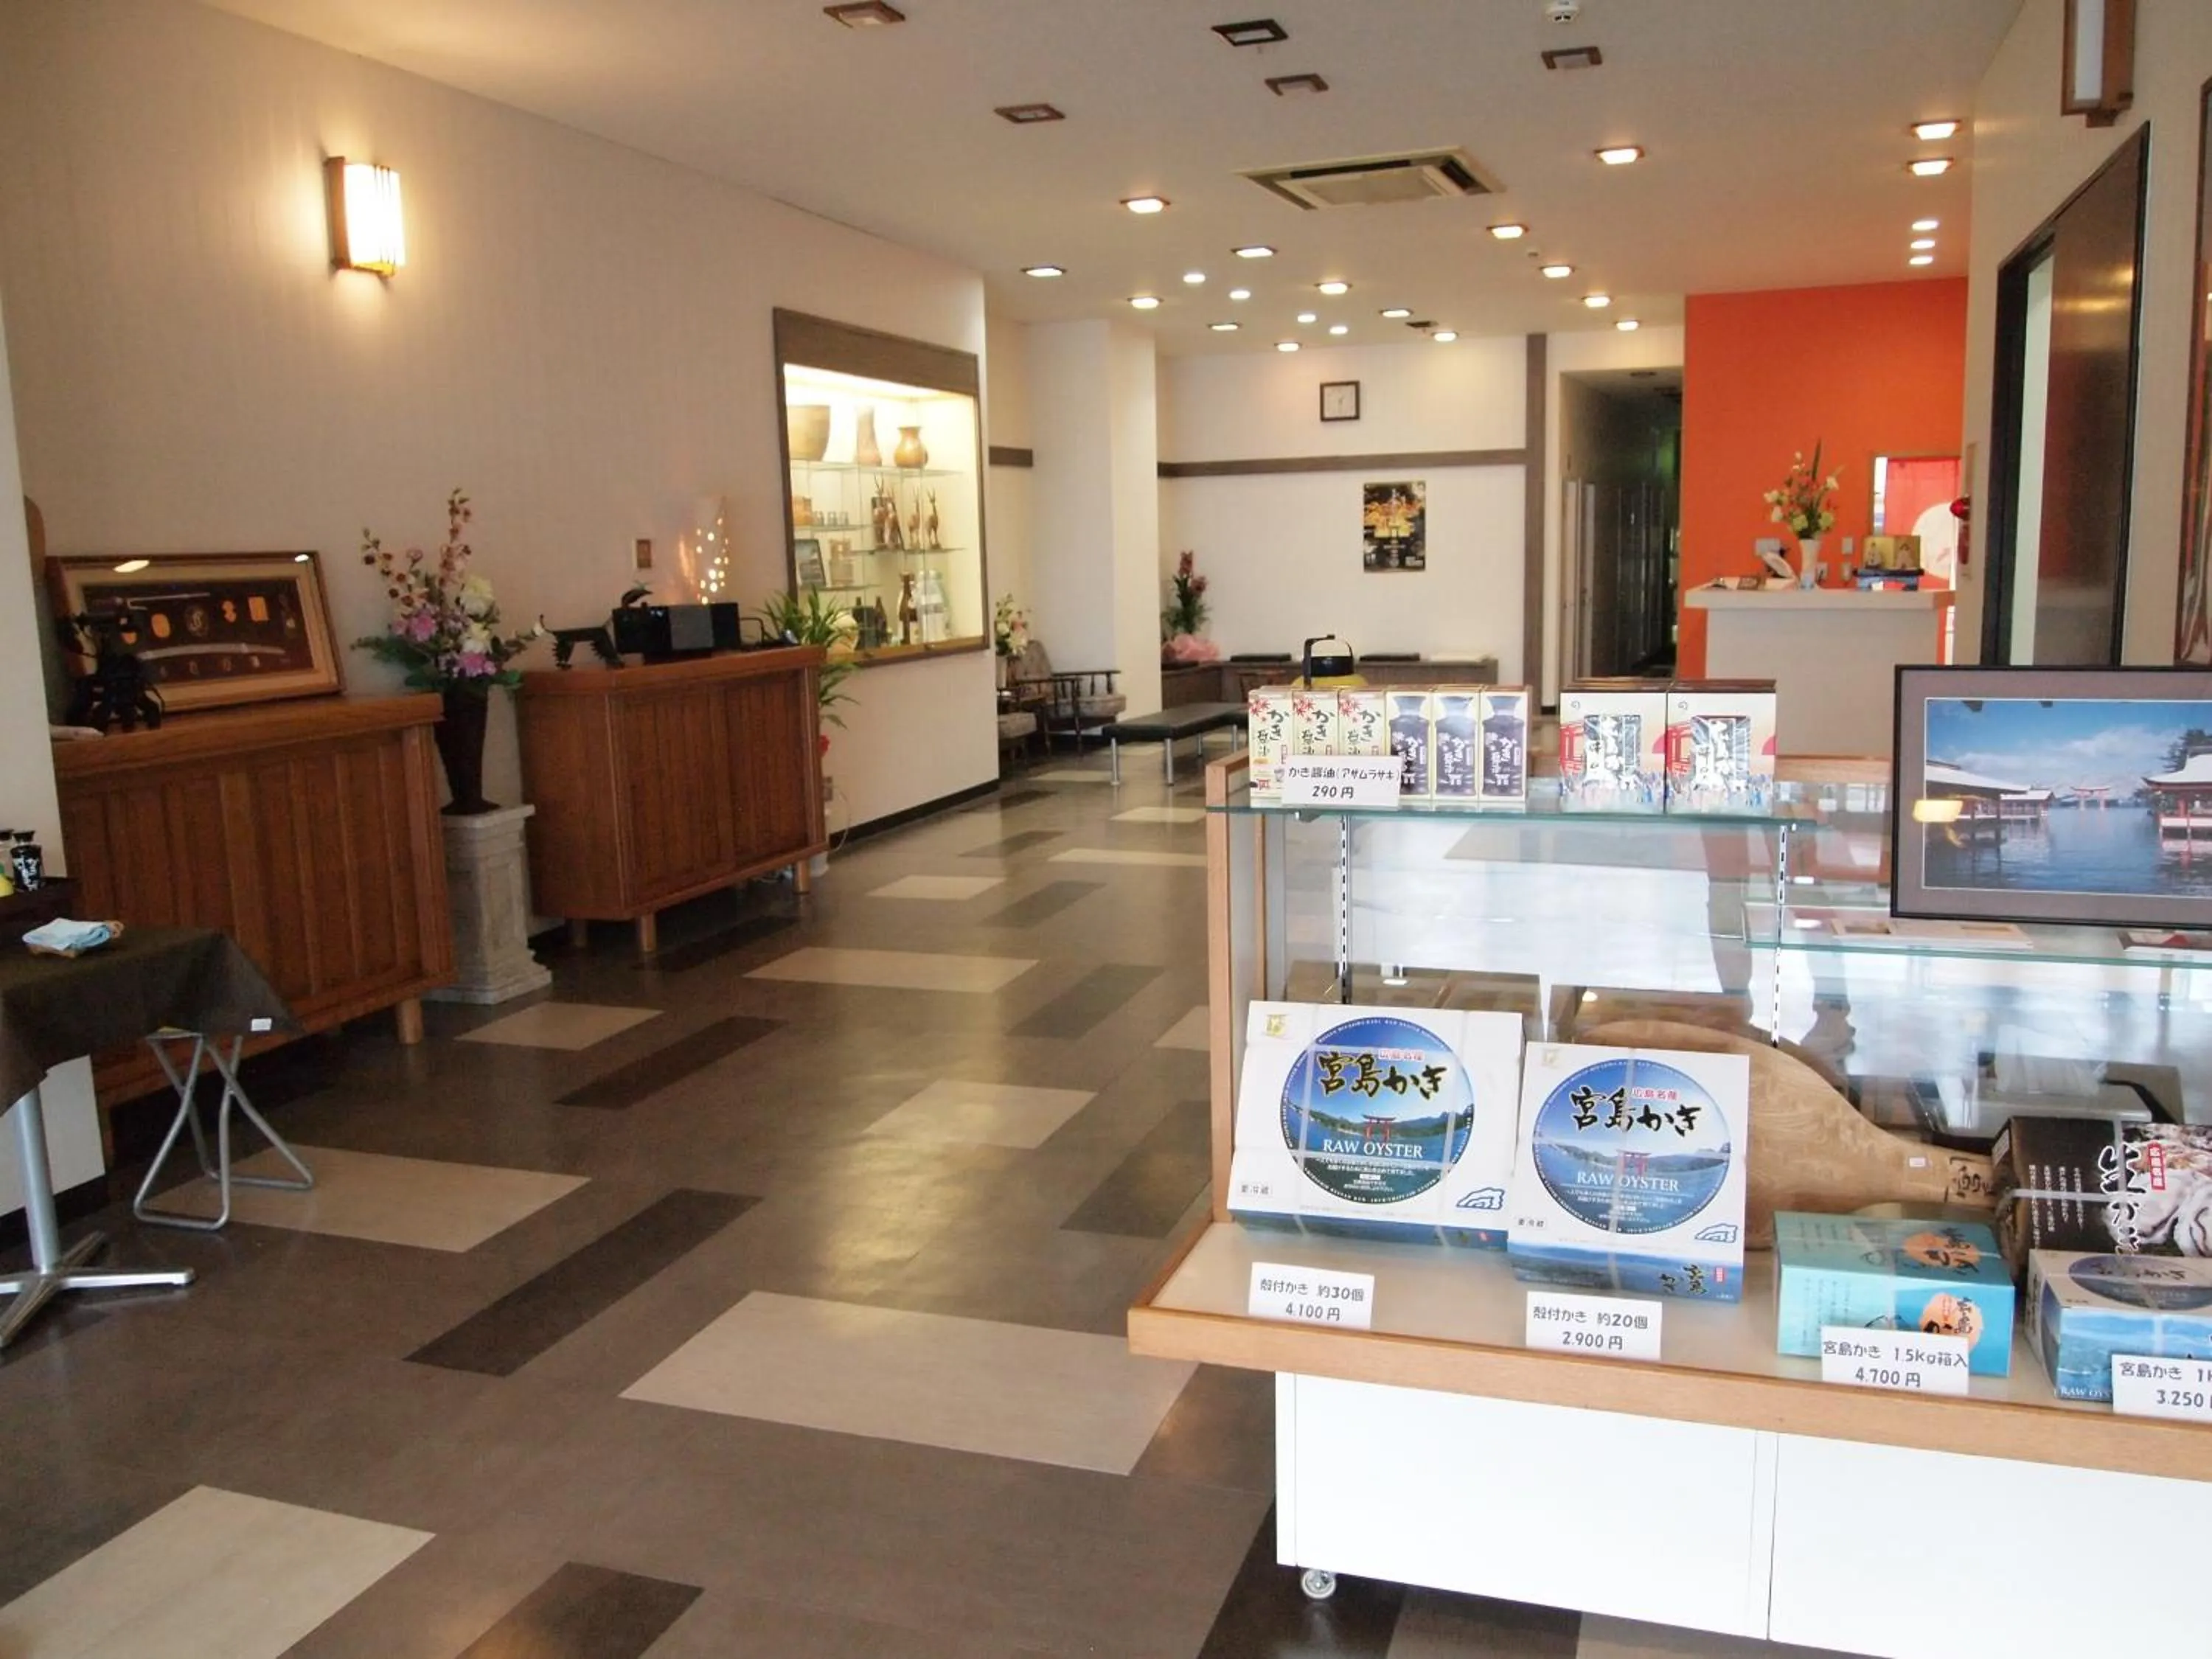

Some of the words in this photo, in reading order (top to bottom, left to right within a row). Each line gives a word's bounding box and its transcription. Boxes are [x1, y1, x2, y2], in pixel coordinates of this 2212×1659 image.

[1318, 1051, 1447, 1099] 宮島かき
[1571, 1086, 1701, 1136] 宮島かき
[1324, 1139, 1360, 1153] RAW
[1363, 1141, 1423, 1160] OYSTER
[1577, 1171, 1614, 1186] RAW
[1619, 1174, 1679, 1192] OYSTER
[1318, 1285, 1364, 1301] 約30個
[1533, 1306, 1587, 1324] 殻付かき
[1598, 1312, 1648, 1329] 約20個
[1823, 1340, 1882, 1359] 宮島かき
[2119, 1363, 2182, 1380] 宮島かき
